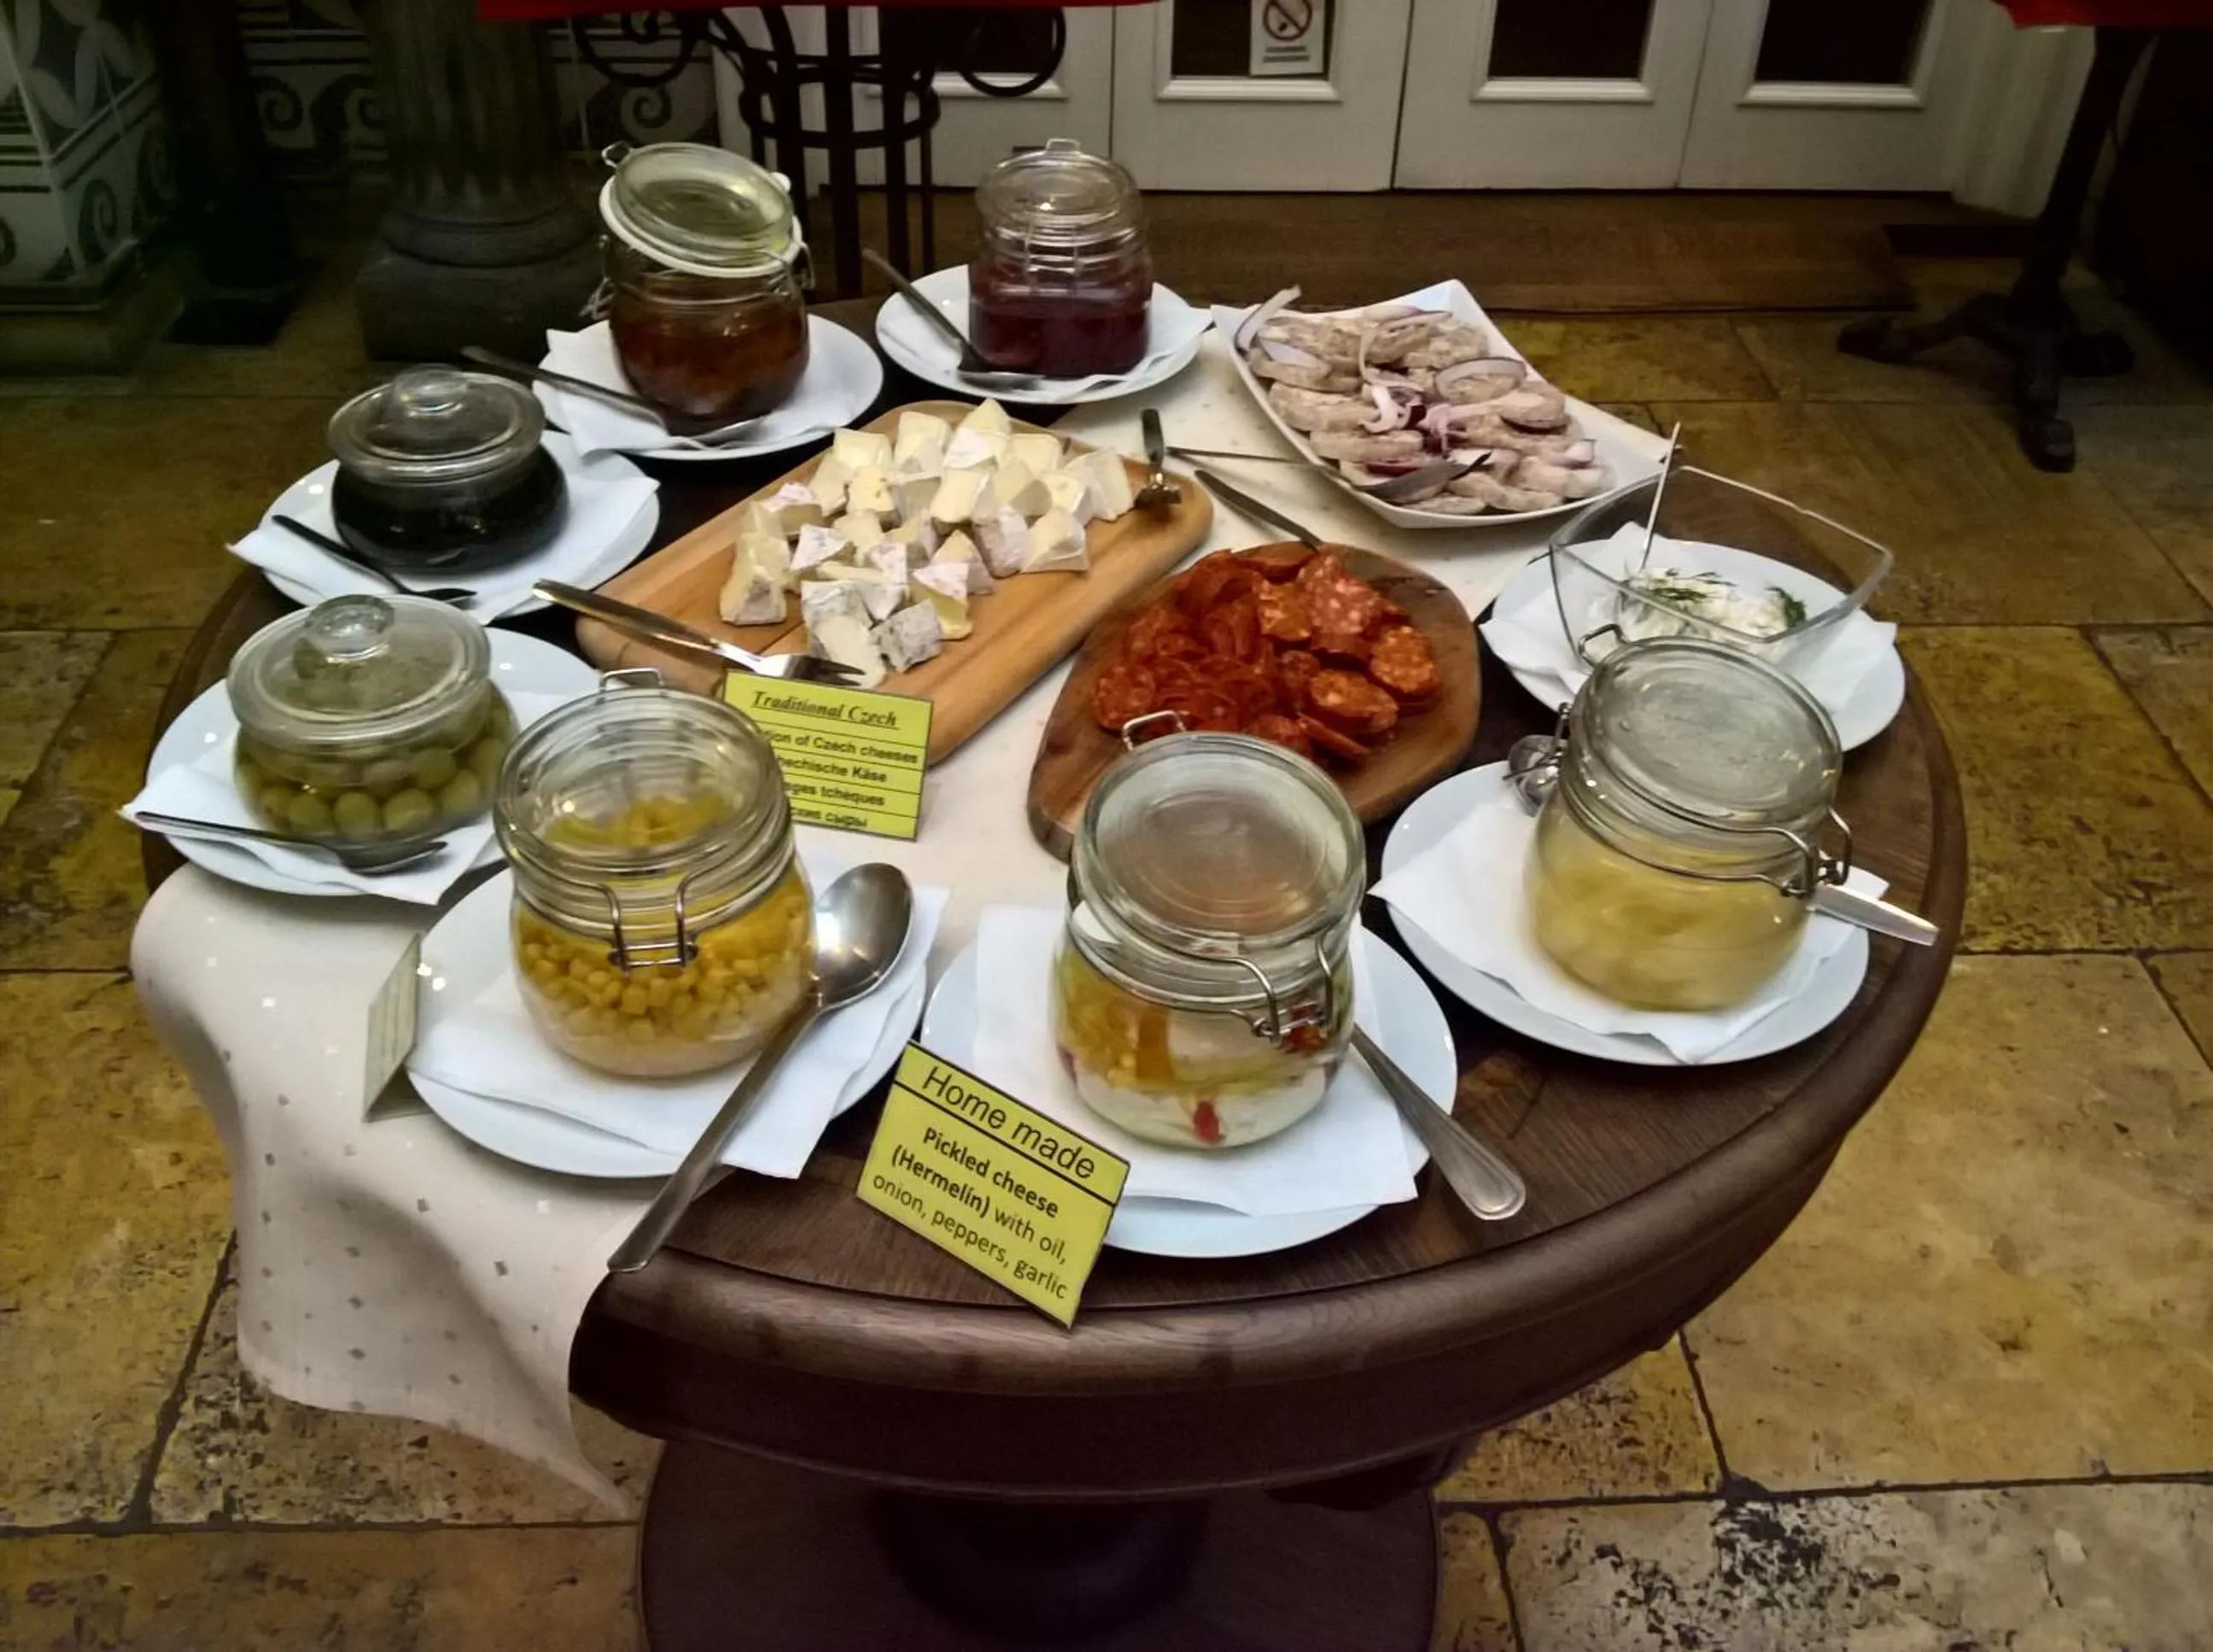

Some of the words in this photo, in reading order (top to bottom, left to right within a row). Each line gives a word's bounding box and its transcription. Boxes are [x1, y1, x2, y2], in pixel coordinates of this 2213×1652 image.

[794, 734, 810, 746] of
[814, 736, 856, 755] Czech
[860, 745, 918, 765] cheeses
[848, 705, 897, 726] Czech
[922, 1065, 1007, 1130] Home
[1011, 1121, 1095, 1180] made
[923, 1126, 991, 1177] Pickled
[992, 1165, 1060, 1218] cheese
[873, 1174, 926, 1219] onion,
[931, 1209, 1009, 1269] peppers,
[1013, 1258, 1068, 1299] garlic
[995, 1205, 1036, 1243] with
[1038, 1235, 1067, 1264] oil,
